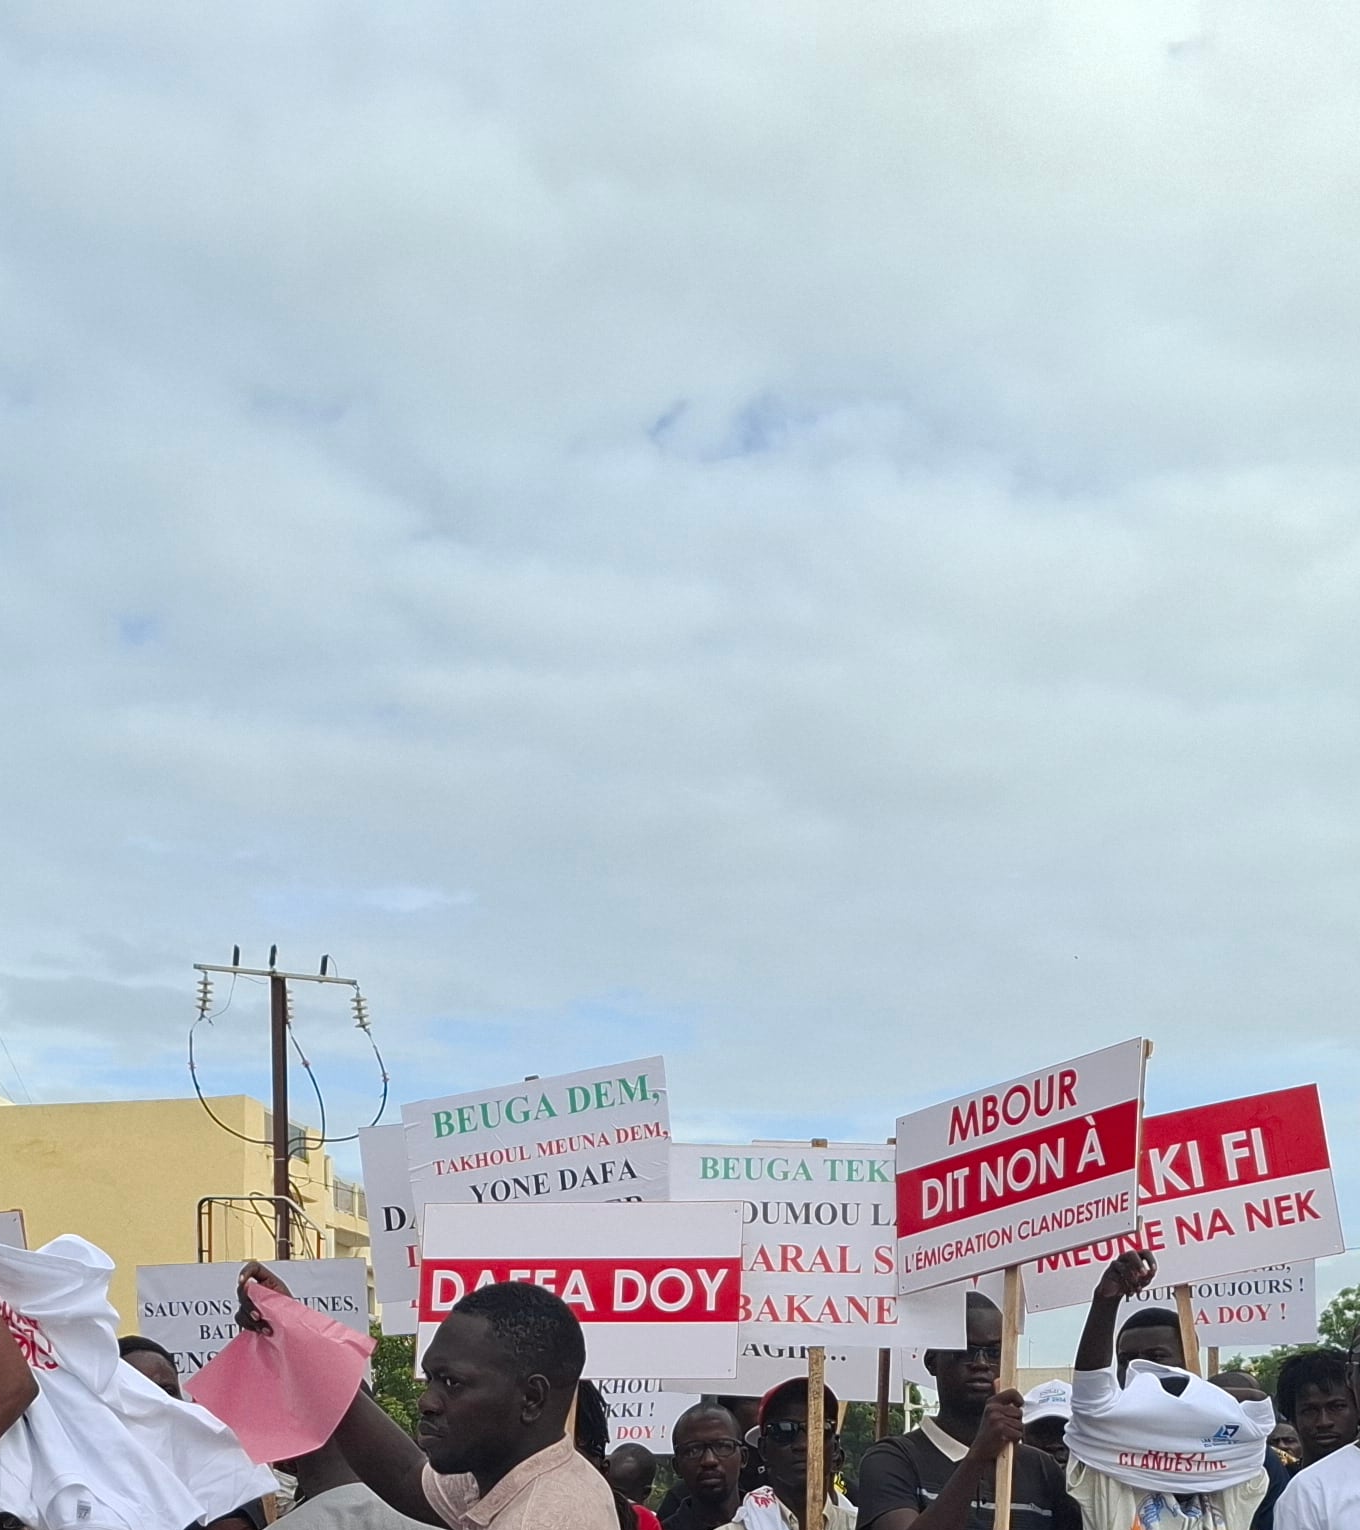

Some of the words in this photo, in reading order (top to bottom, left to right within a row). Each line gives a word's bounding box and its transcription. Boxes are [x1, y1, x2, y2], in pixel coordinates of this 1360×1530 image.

[433, 1093, 558, 1138] BEUGA
[566, 1074, 660, 1114] DEM,
[949, 1068, 1078, 1146] MBOUR
[433, 1146, 531, 1175] TAKHOUL
[536, 1133, 610, 1157] MEUNA
[615, 1122, 668, 1144] DEM,
[699, 1157, 814, 1181] BEUGA
[921, 1166, 969, 1220] DIT
[980, 1137, 1065, 1202] NON
[1077, 1117, 1106, 1173] À
[1221, 1127, 1268, 1181] FI
[470, 1173, 550, 1203] YONE
[558, 1158, 637, 1191] DAFA
[871, 1204, 897, 1226] L
[905, 1224, 1013, 1274] L'ÉMIGRATION
[1017, 1191, 1130, 1240] CLANDESTINE
[1174, 1207, 1236, 1246] NA
[1246, 1189, 1321, 1232] NEK
[741, 1244, 862, 1274] ARAL
[874, 1245, 895, 1275] S
[144, 1300, 232, 1318] SAUVONS
[293, 1295, 359, 1314] UNES,
[613, 1268, 728, 1312] DOY
[1189, 1278, 1292, 1299] TOUJOURS
[1299, 1277, 1304, 1291] !
[200, 1323, 242, 1339] BAT
[1218, 1303, 1272, 1325] DOY
[1280, 1303, 1286, 1320] !
[616, 1425, 655, 1440] DOY
